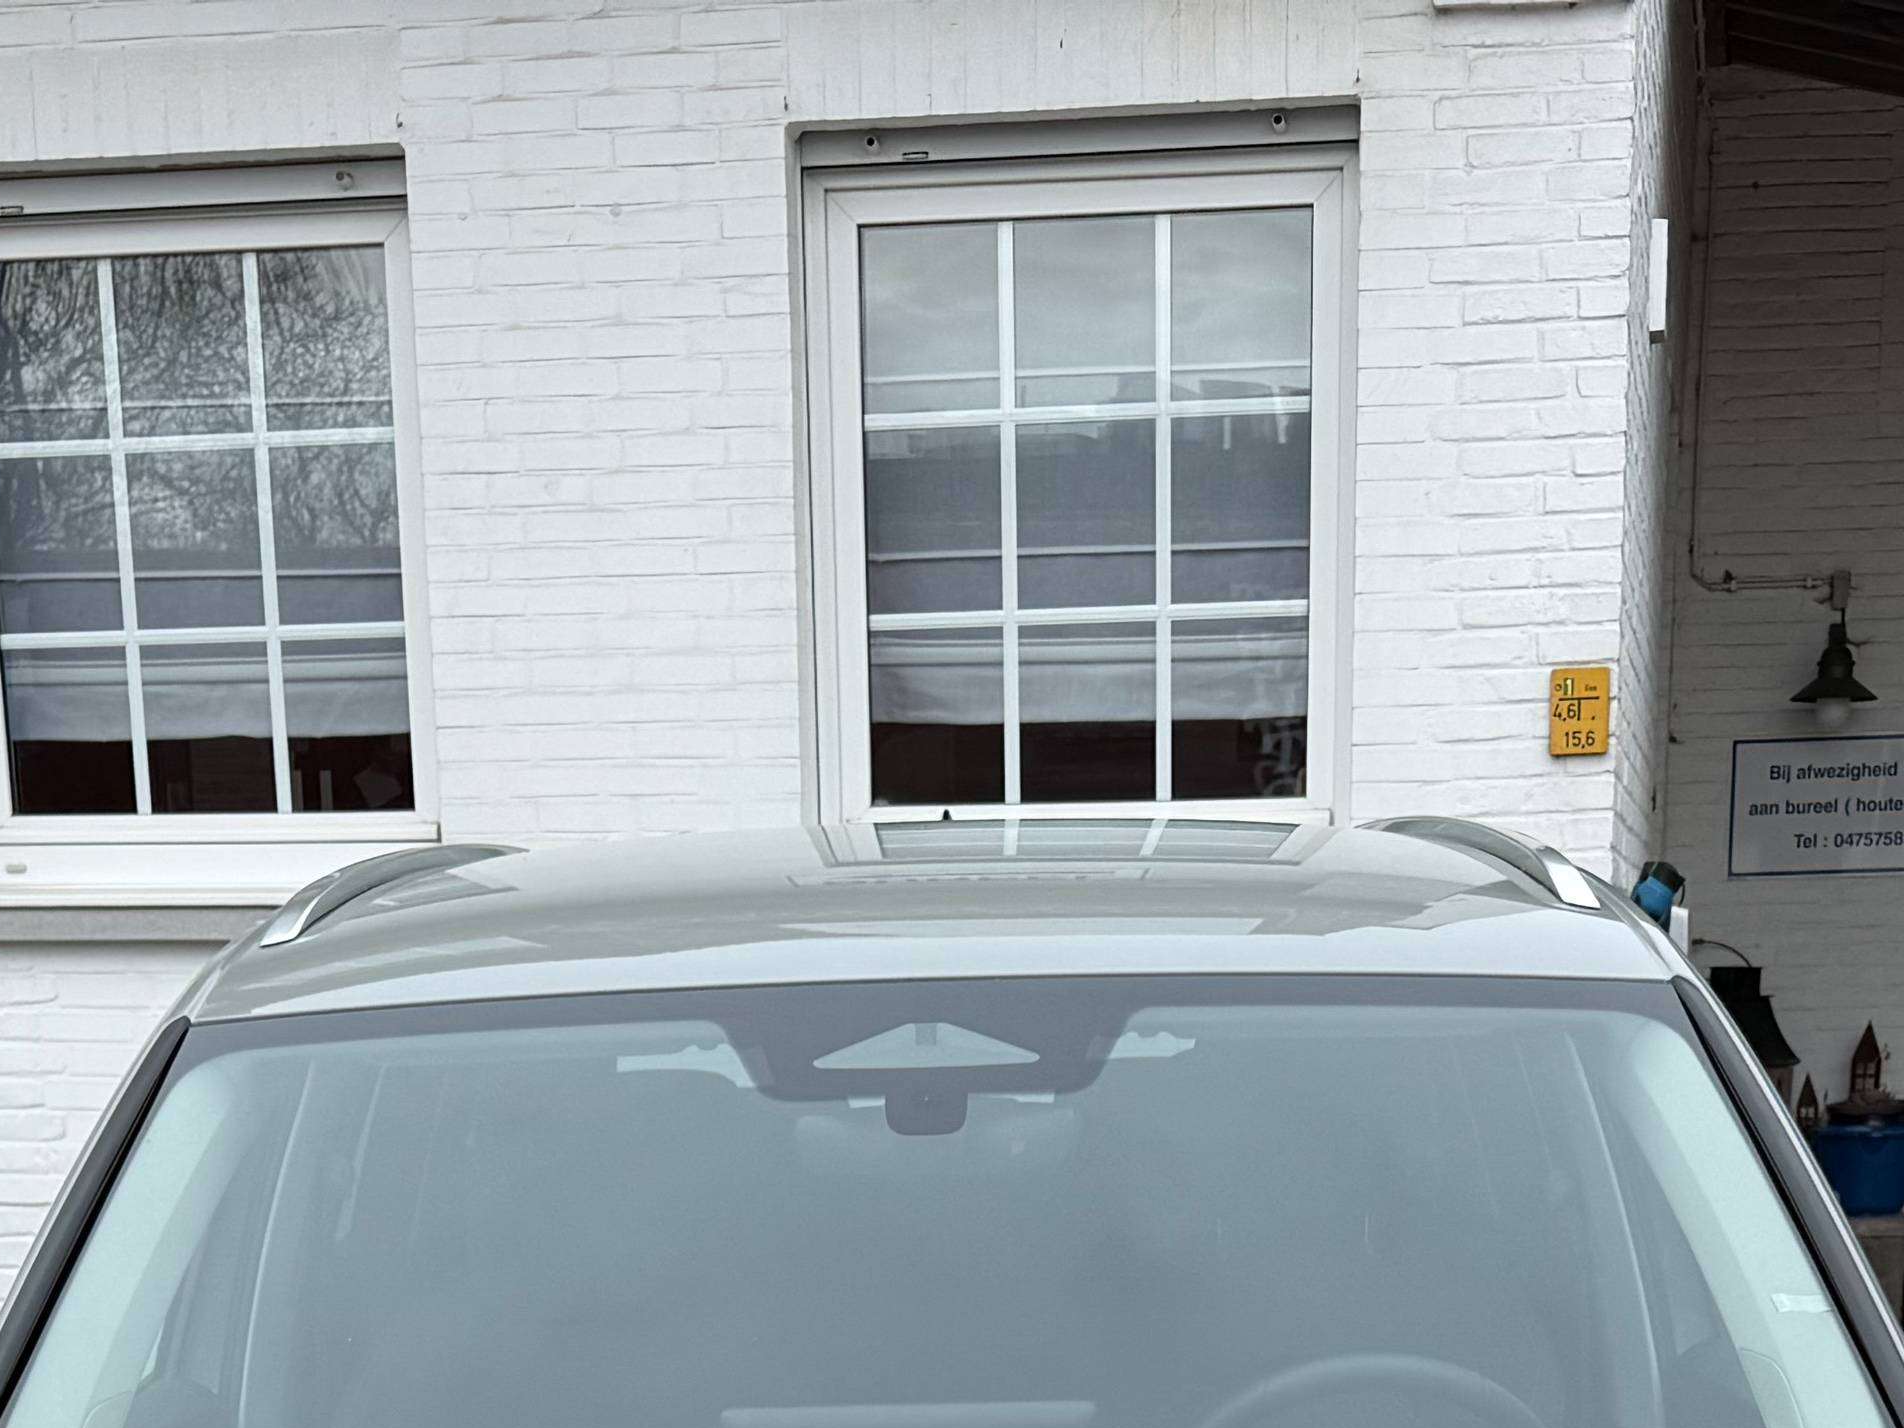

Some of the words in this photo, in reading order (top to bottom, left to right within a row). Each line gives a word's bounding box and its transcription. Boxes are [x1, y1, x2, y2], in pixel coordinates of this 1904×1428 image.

[1565, 730, 1596, 749] 15,6
[1769, 764, 1792, 783] Bij
[1796, 761, 1897, 782] afwezigheid
[1749, 803, 1779, 816] aan
[1785, 798, 1838, 815] bureel
[1794, 833, 1818, 849] Tel
